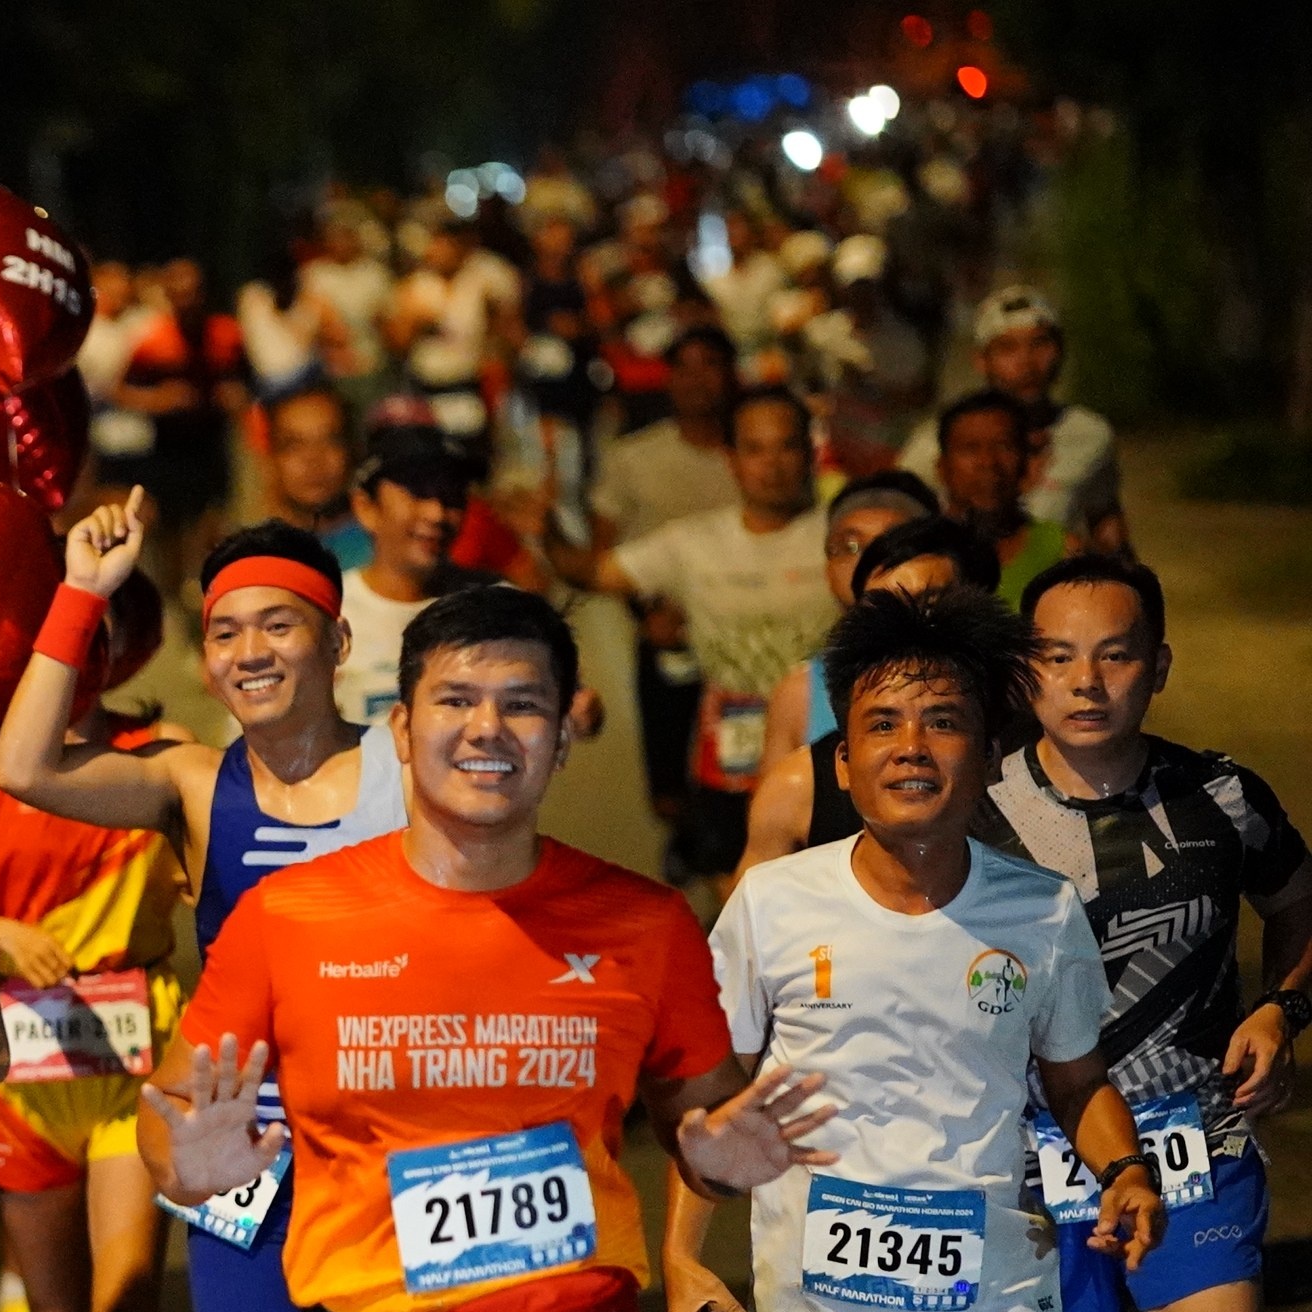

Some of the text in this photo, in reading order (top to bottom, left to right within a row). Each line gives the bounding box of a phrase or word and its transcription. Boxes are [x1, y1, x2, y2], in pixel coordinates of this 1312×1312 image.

[319, 960, 401, 978] Herbalife
[978, 1000, 1015, 1015] GDC
[337, 1014, 598, 1048] VNEXPRESS MARATHON
[337, 1048, 597, 1090] NHA TRANG 2024
[425, 1175, 569, 1245] 21789
[876, 1202, 920, 1215] MARATHON
[1059, 1208, 1086, 1219] HALF
[827, 1222, 963, 1277] 21345
[419, 1258, 526, 1287] HALF MARATHON
[814, 1282, 905, 1306] HALF MARATHON
